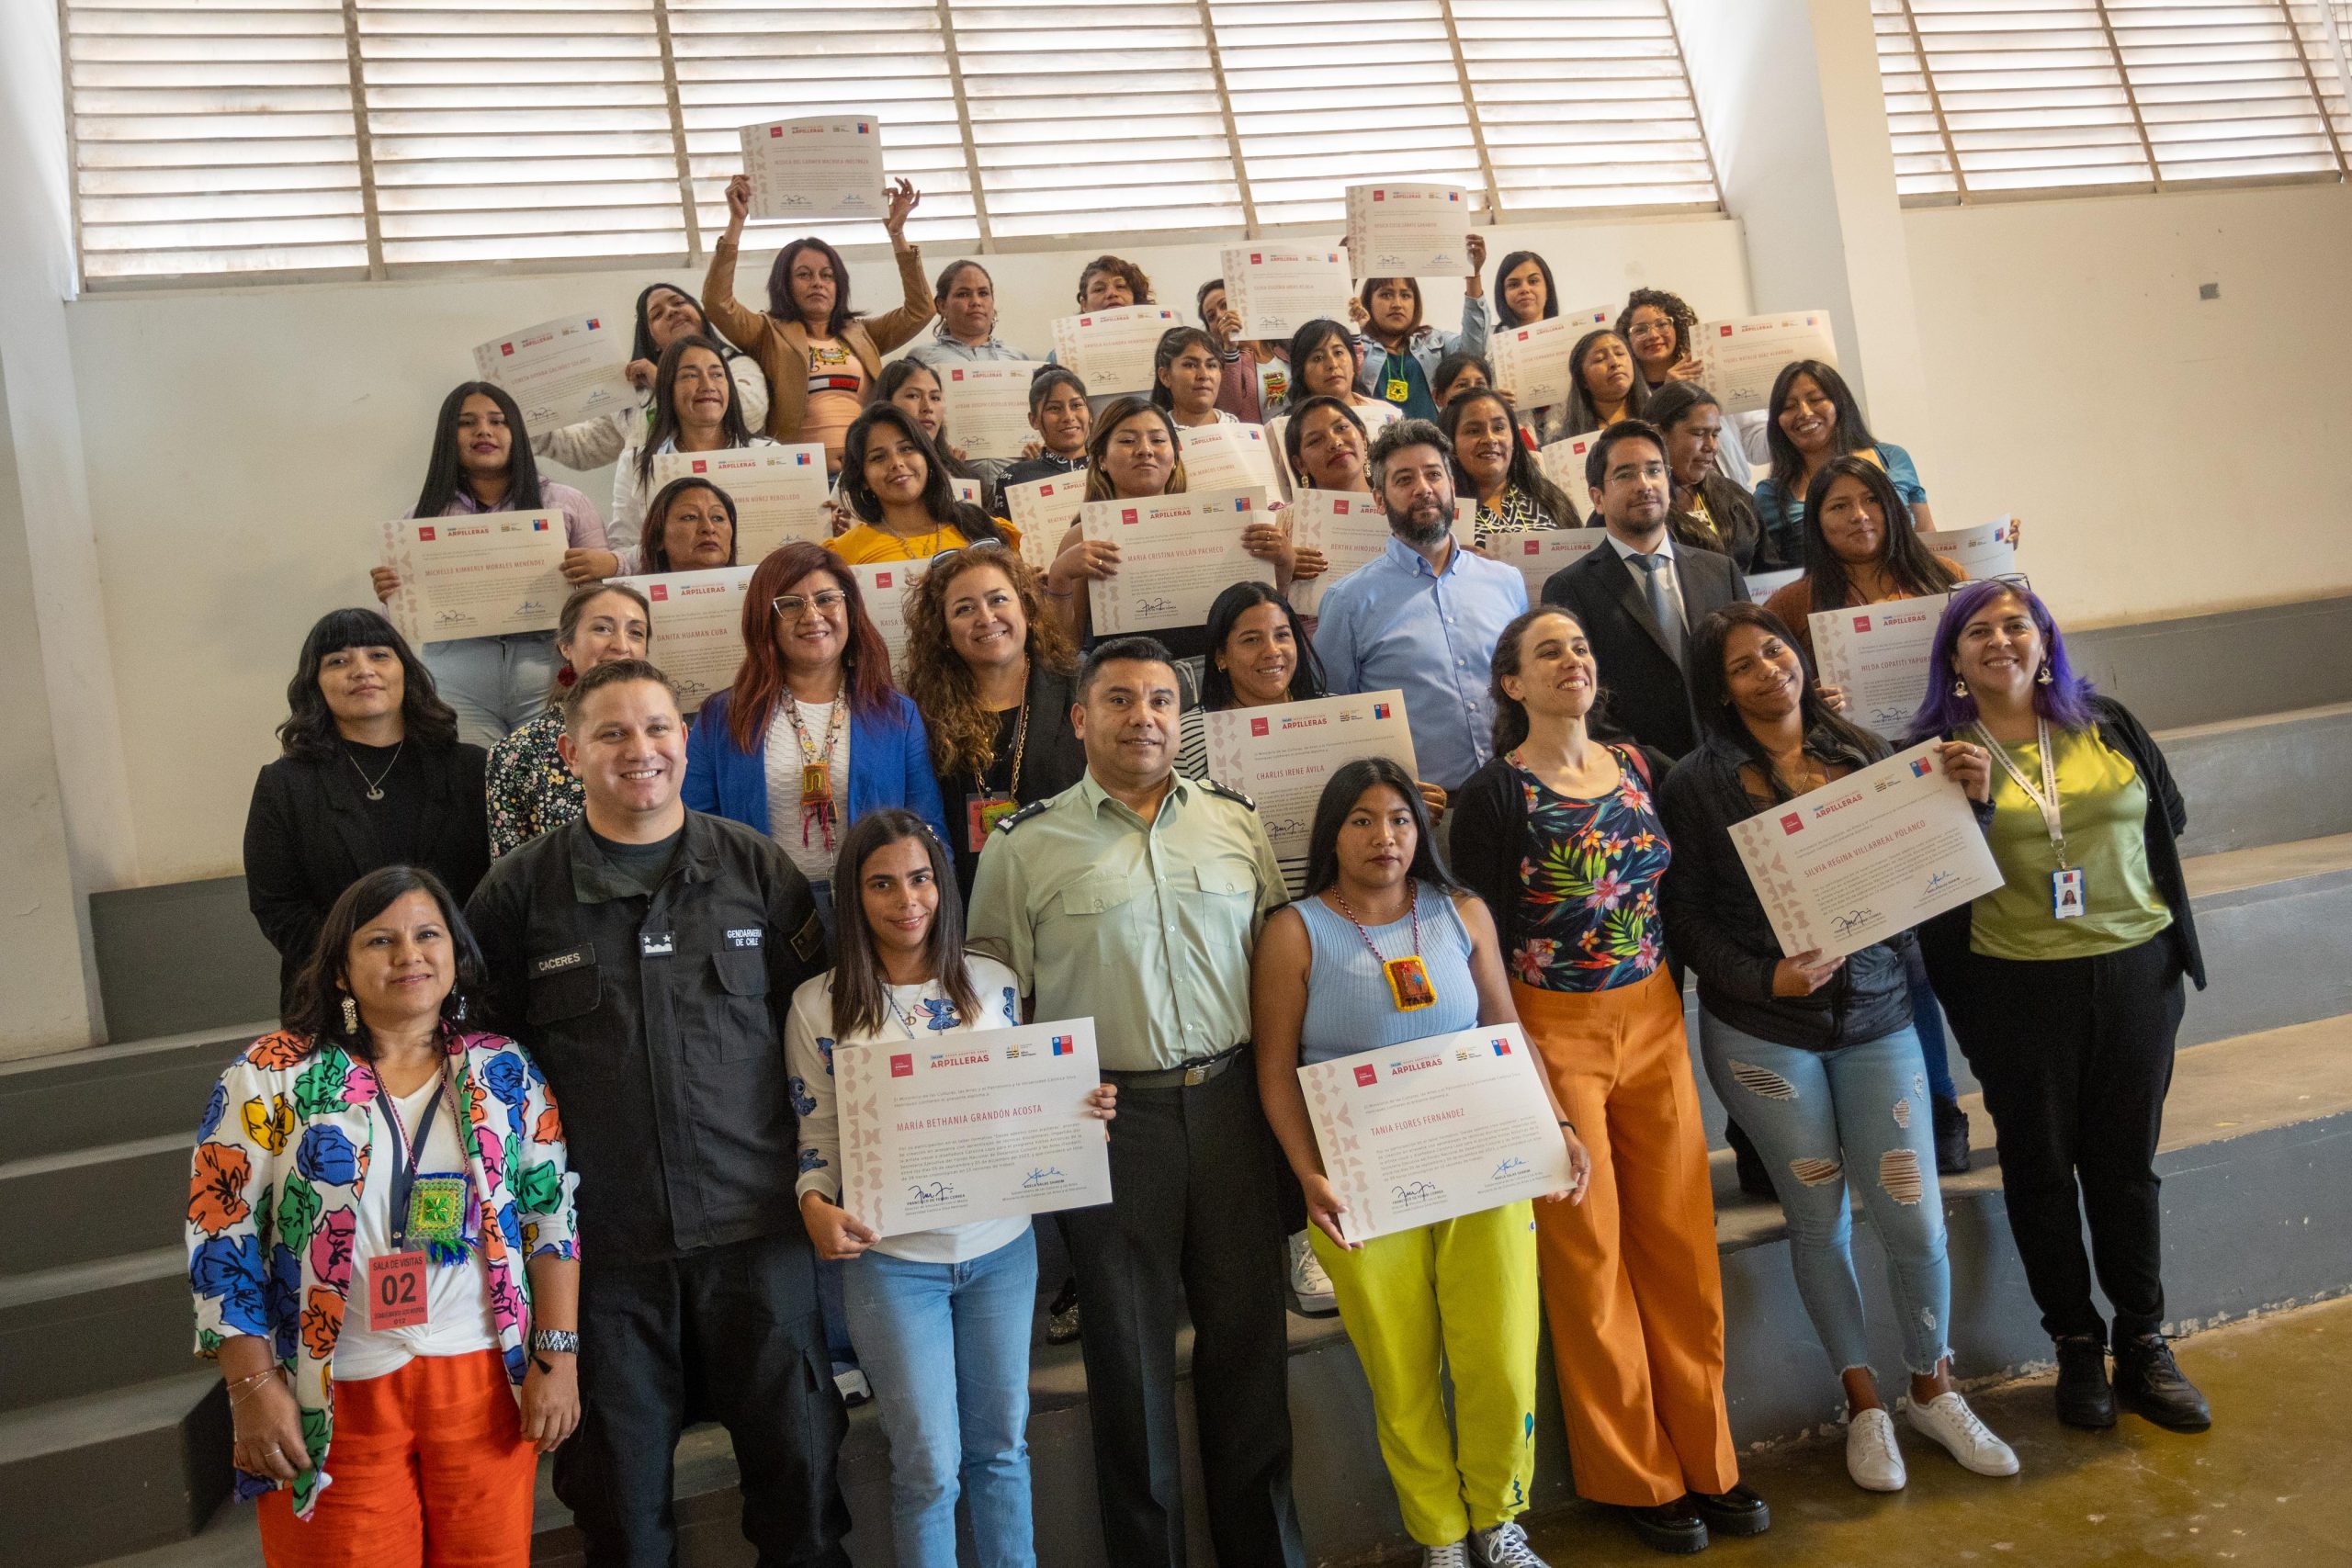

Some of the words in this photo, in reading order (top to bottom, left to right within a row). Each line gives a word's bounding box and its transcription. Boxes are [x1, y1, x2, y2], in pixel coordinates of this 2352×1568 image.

[1150, 509, 1191, 519] ARPILLERAS
[681, 587, 725, 596] ARPILLERAS
[1883, 615, 1926, 626] ARPILLERAS
[711, 628, 728, 637] CUBA
[1282, 717, 1328, 730] ARPILLERAS
[1257, 770, 1283, 781] CHARLIS
[1285, 767, 1304, 778] IRENE
[1305, 764, 1325, 775] ÁVILA
[1815, 793, 1863, 819] ARPILLERAS
[1804, 863, 1826, 878] SILVIA
[1826, 852, 1853, 869] REGINA
[1854, 835, 1894, 858] VILLARREAL
[1894, 819, 1927, 840] POLANCO
[735, 937, 744, 947] DE
[745, 936, 759, 946] CHILE
[538, 953, 581, 971] CACERES
[931, 1054, 989, 1069] ARPILLERAS
[1391, 1059, 1442, 1076] ARPILLERAS
[896, 1118, 924, 1132] MARÍA
[927, 1113, 968, 1130] BETHANIA
[971, 1106, 1011, 1124] GRANDÓN
[1012, 1104, 1043, 1119] ACOSTA
[1371, 1124, 1394, 1136] TANIA
[1395, 1117, 1422, 1134] FLORES
[1423, 1107, 1465, 1125] FERNÁNDEZ
[373, 1262, 390, 1271] SALA
[390, 1259, 398, 1269] DE
[400, 1256, 423, 1268] VISITAS
[382, 1272, 416, 1306] 02
